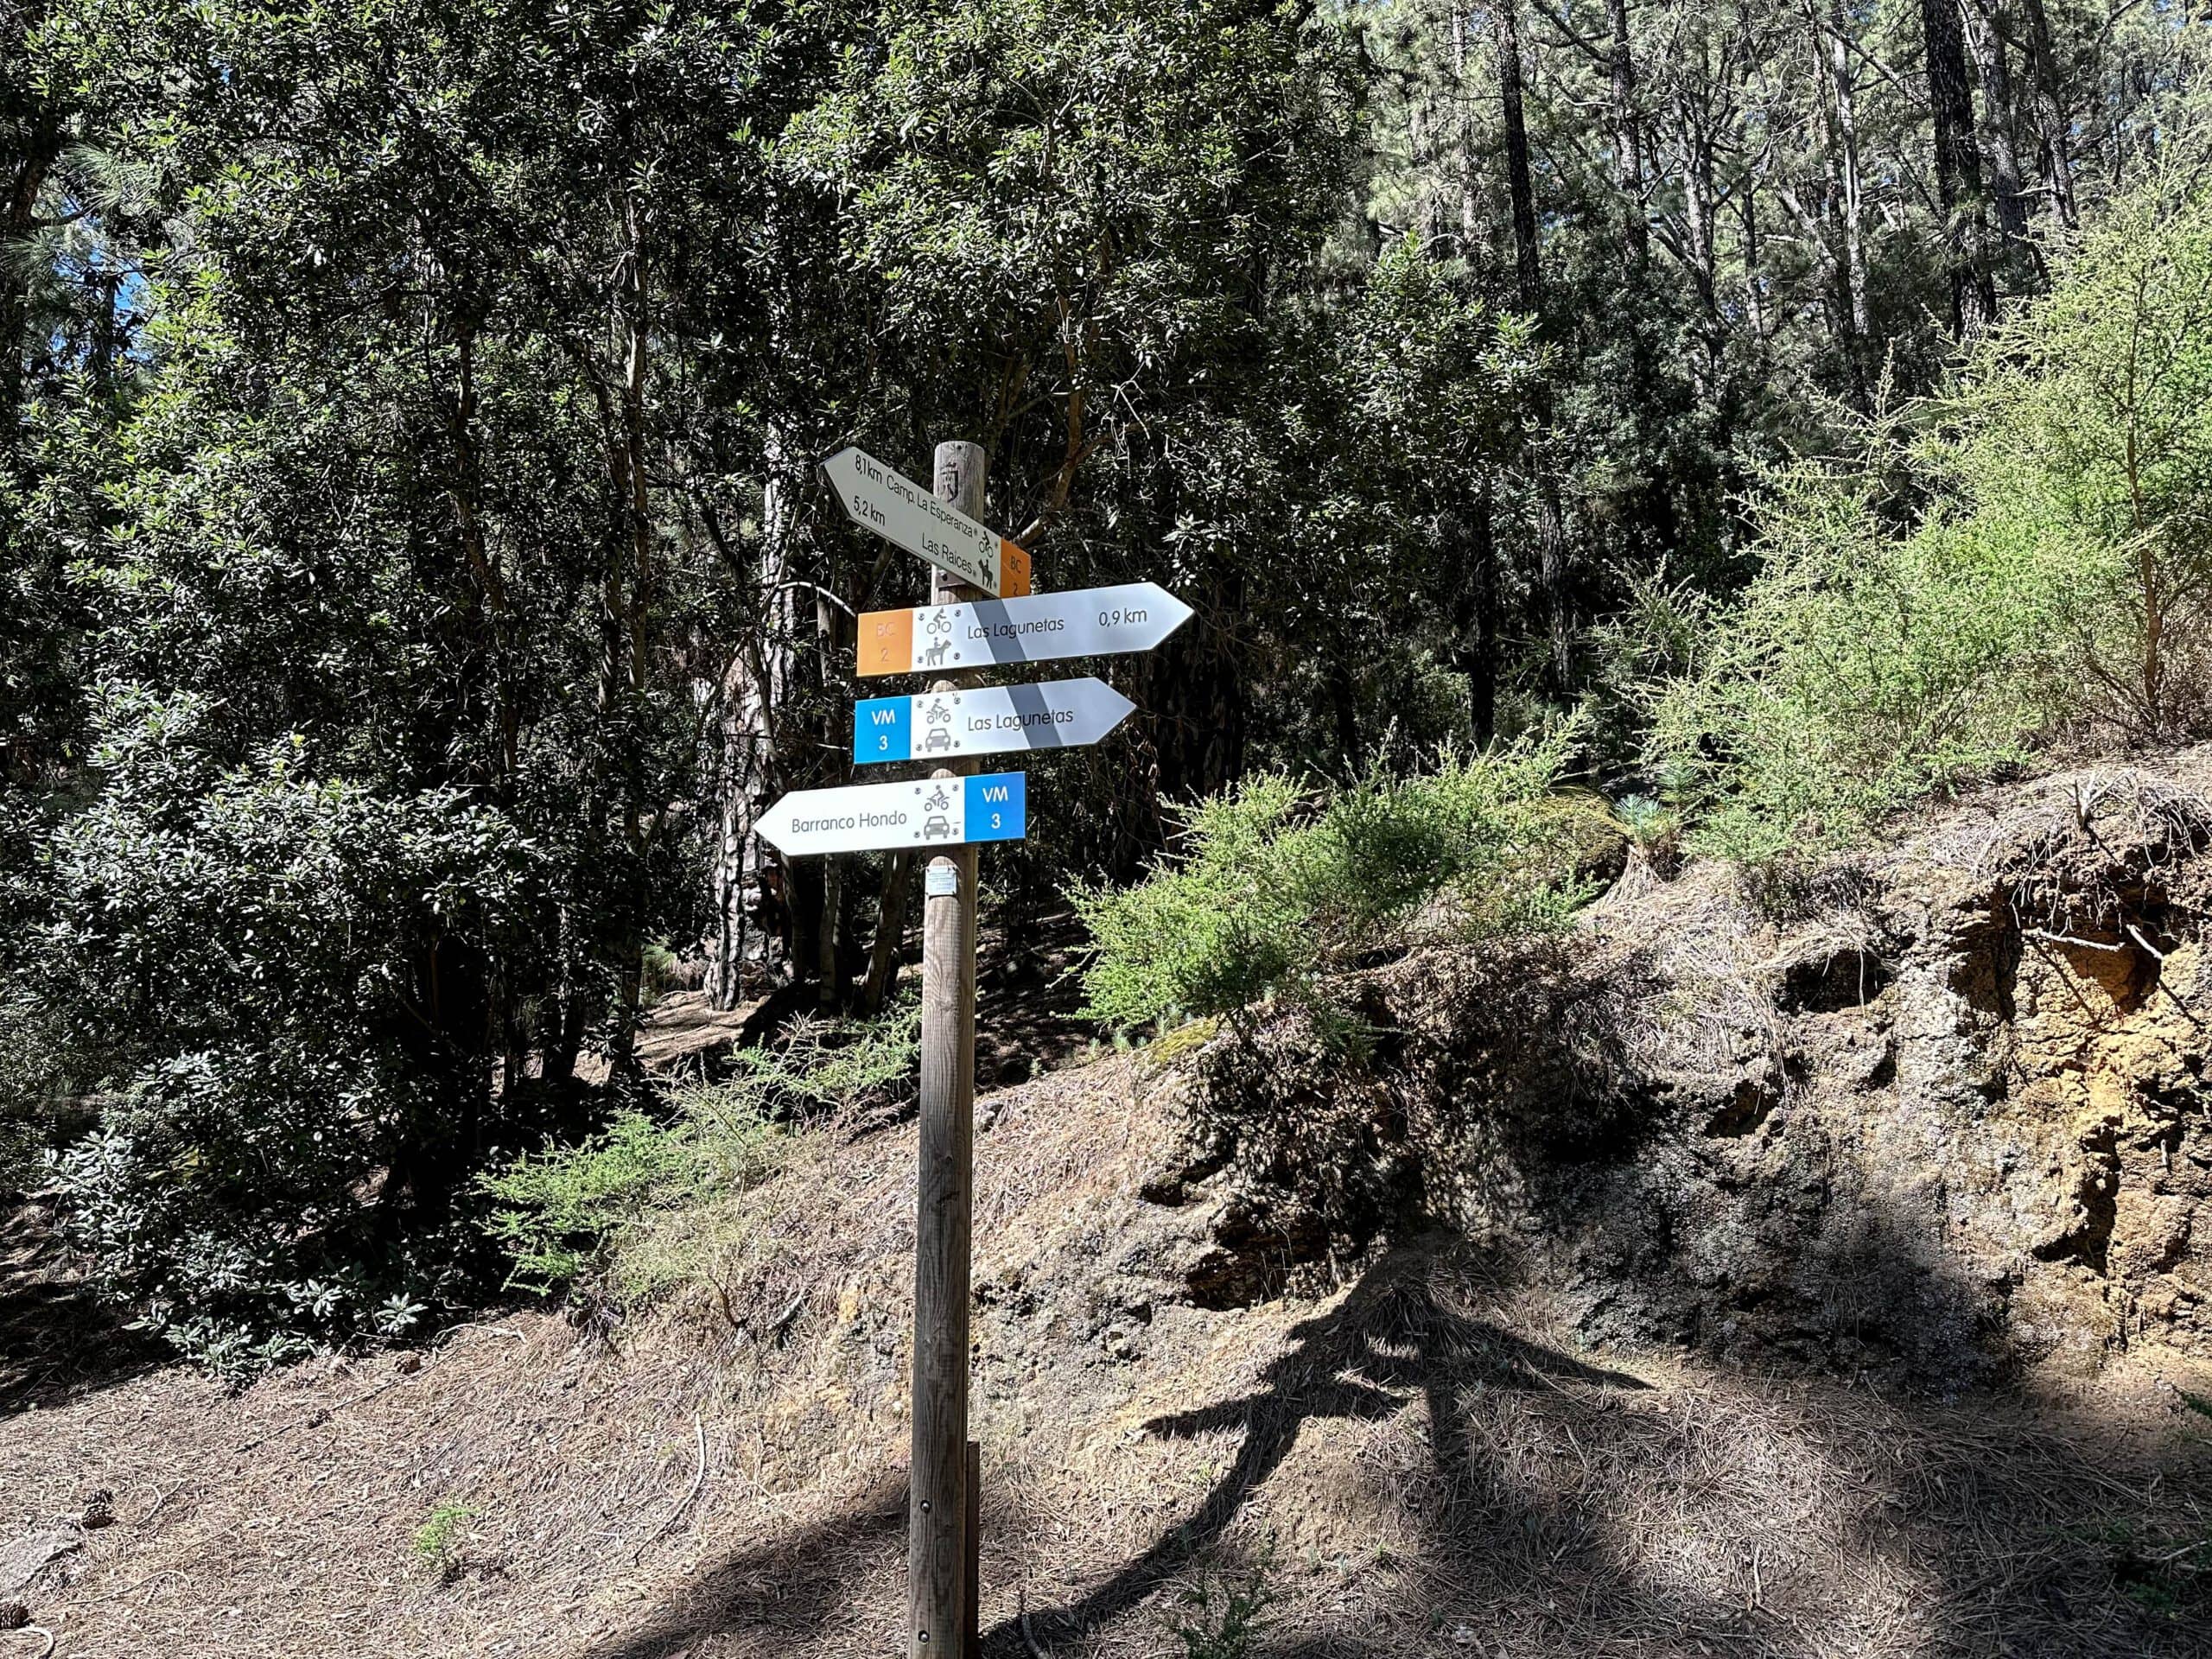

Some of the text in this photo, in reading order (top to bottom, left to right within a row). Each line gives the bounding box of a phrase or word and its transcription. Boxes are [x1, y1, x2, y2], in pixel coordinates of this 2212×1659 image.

[855, 454, 973, 538] 8,1 km Camp. La Esperanza
[854, 496, 868, 518] 5,2
[870, 504, 886, 526] km
[922, 532, 939, 556] Las
[1010, 556, 1021, 574] BC
[1013, 582, 1018, 595] 2
[876, 622, 895, 637] BC
[968, 608, 1147, 639] Las Lagunetas 0,9 km
[880, 649, 889, 663] 2
[871, 709, 895, 725] VM
[968, 709, 1073, 731] Las Lagunetas
[878, 736, 888, 750] 3
[982, 786, 1008, 803] VM
[791, 810, 907, 833] Barranco Hondo
[991, 813, 1001, 829] 3
